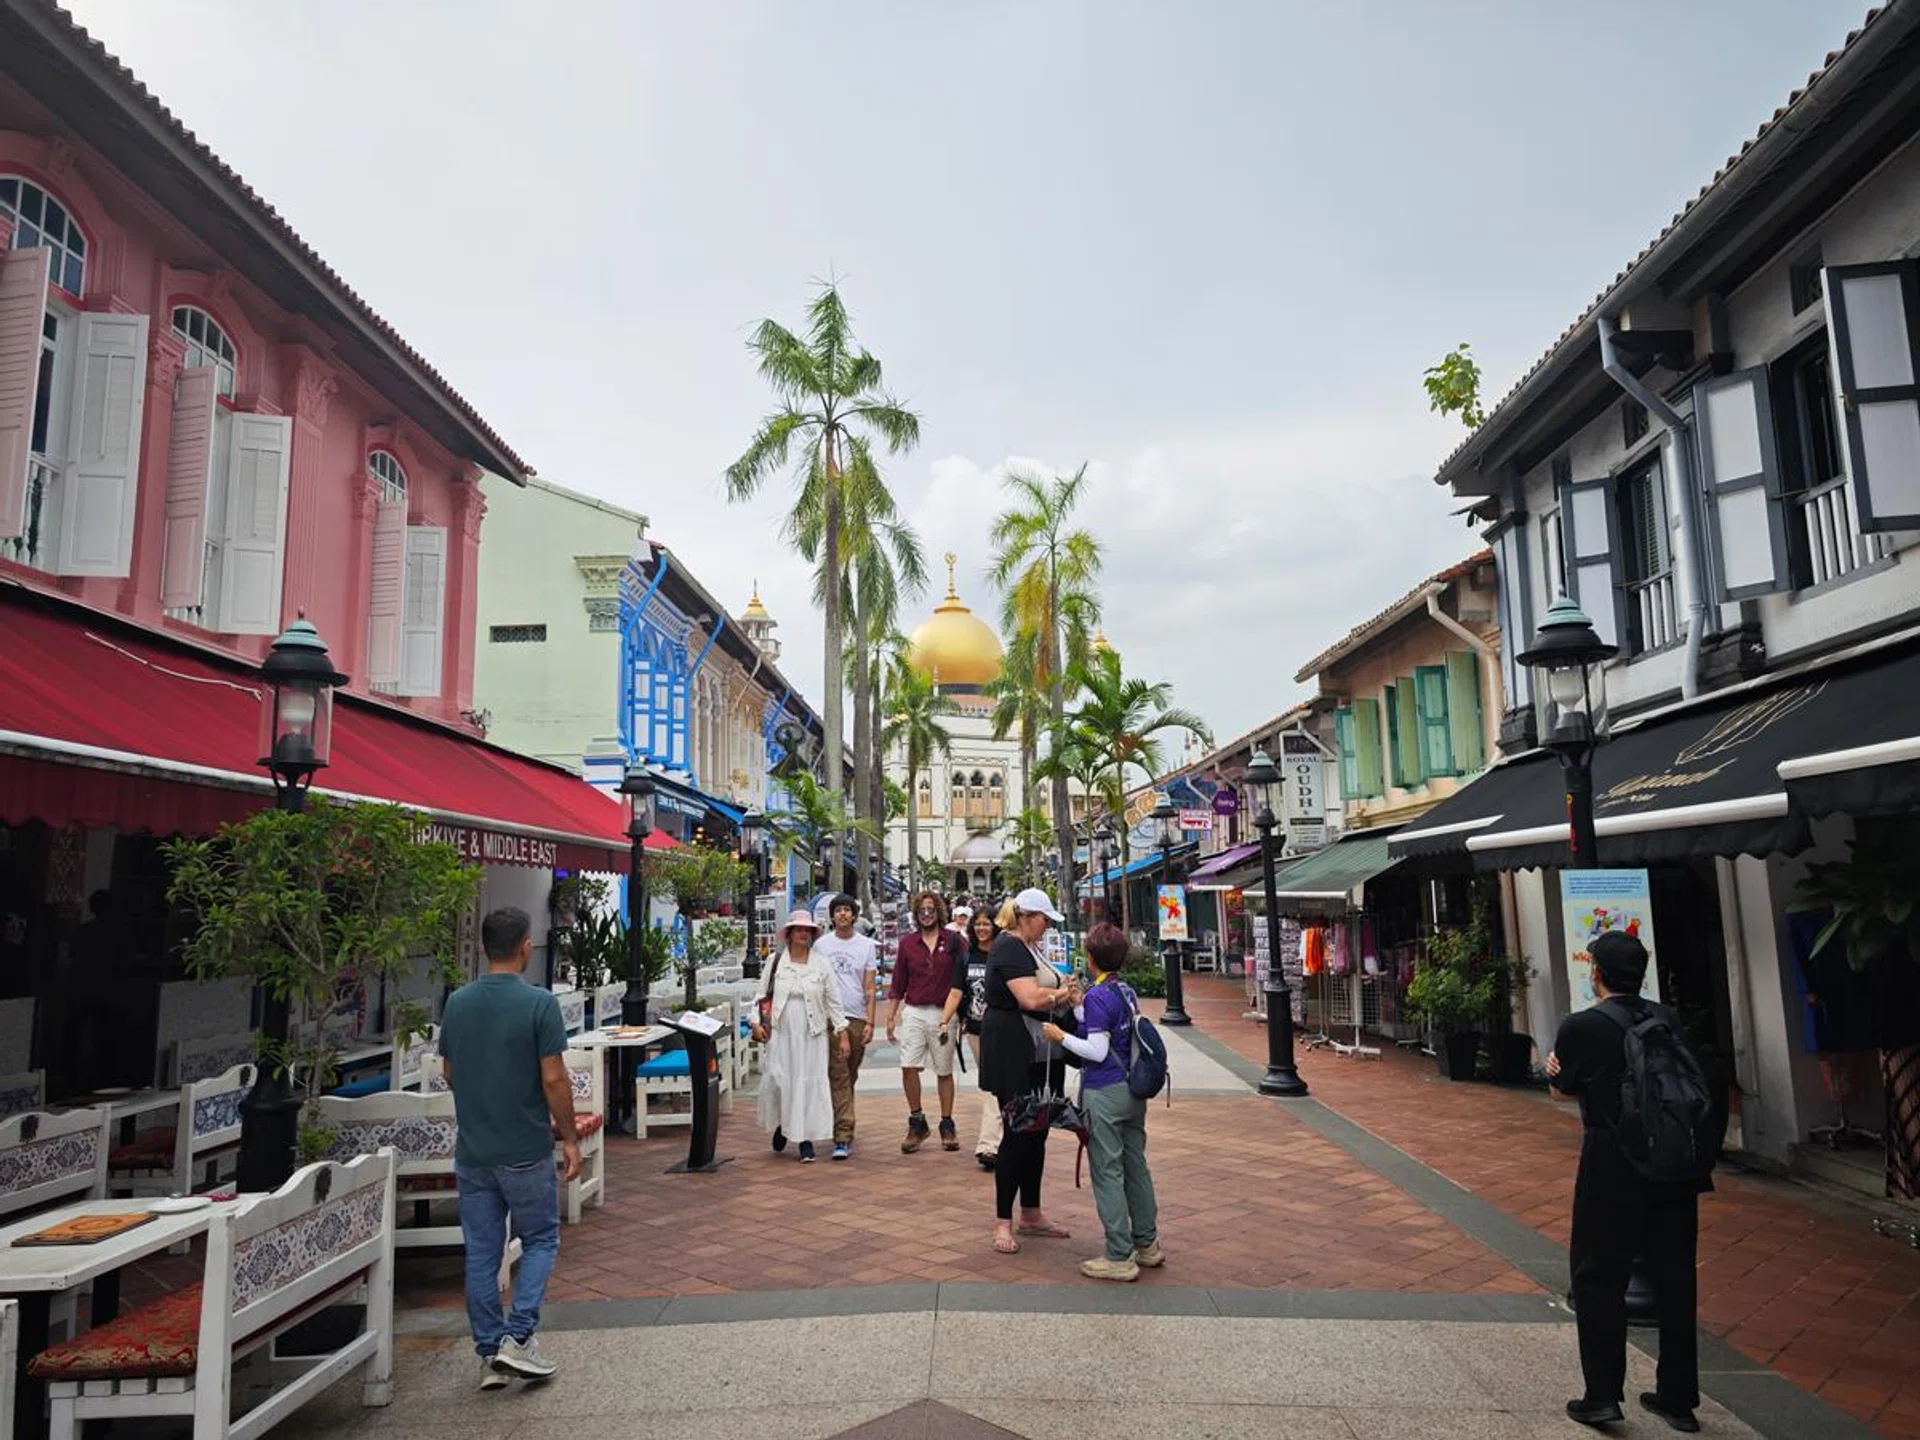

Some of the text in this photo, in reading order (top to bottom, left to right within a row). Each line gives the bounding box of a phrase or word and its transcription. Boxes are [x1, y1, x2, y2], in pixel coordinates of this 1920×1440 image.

[1296, 764, 1313, 807] OUDH
[470, 828, 480, 857] &
[483, 831, 529, 862] MIDDLE
[530, 838, 558, 865] EAST
